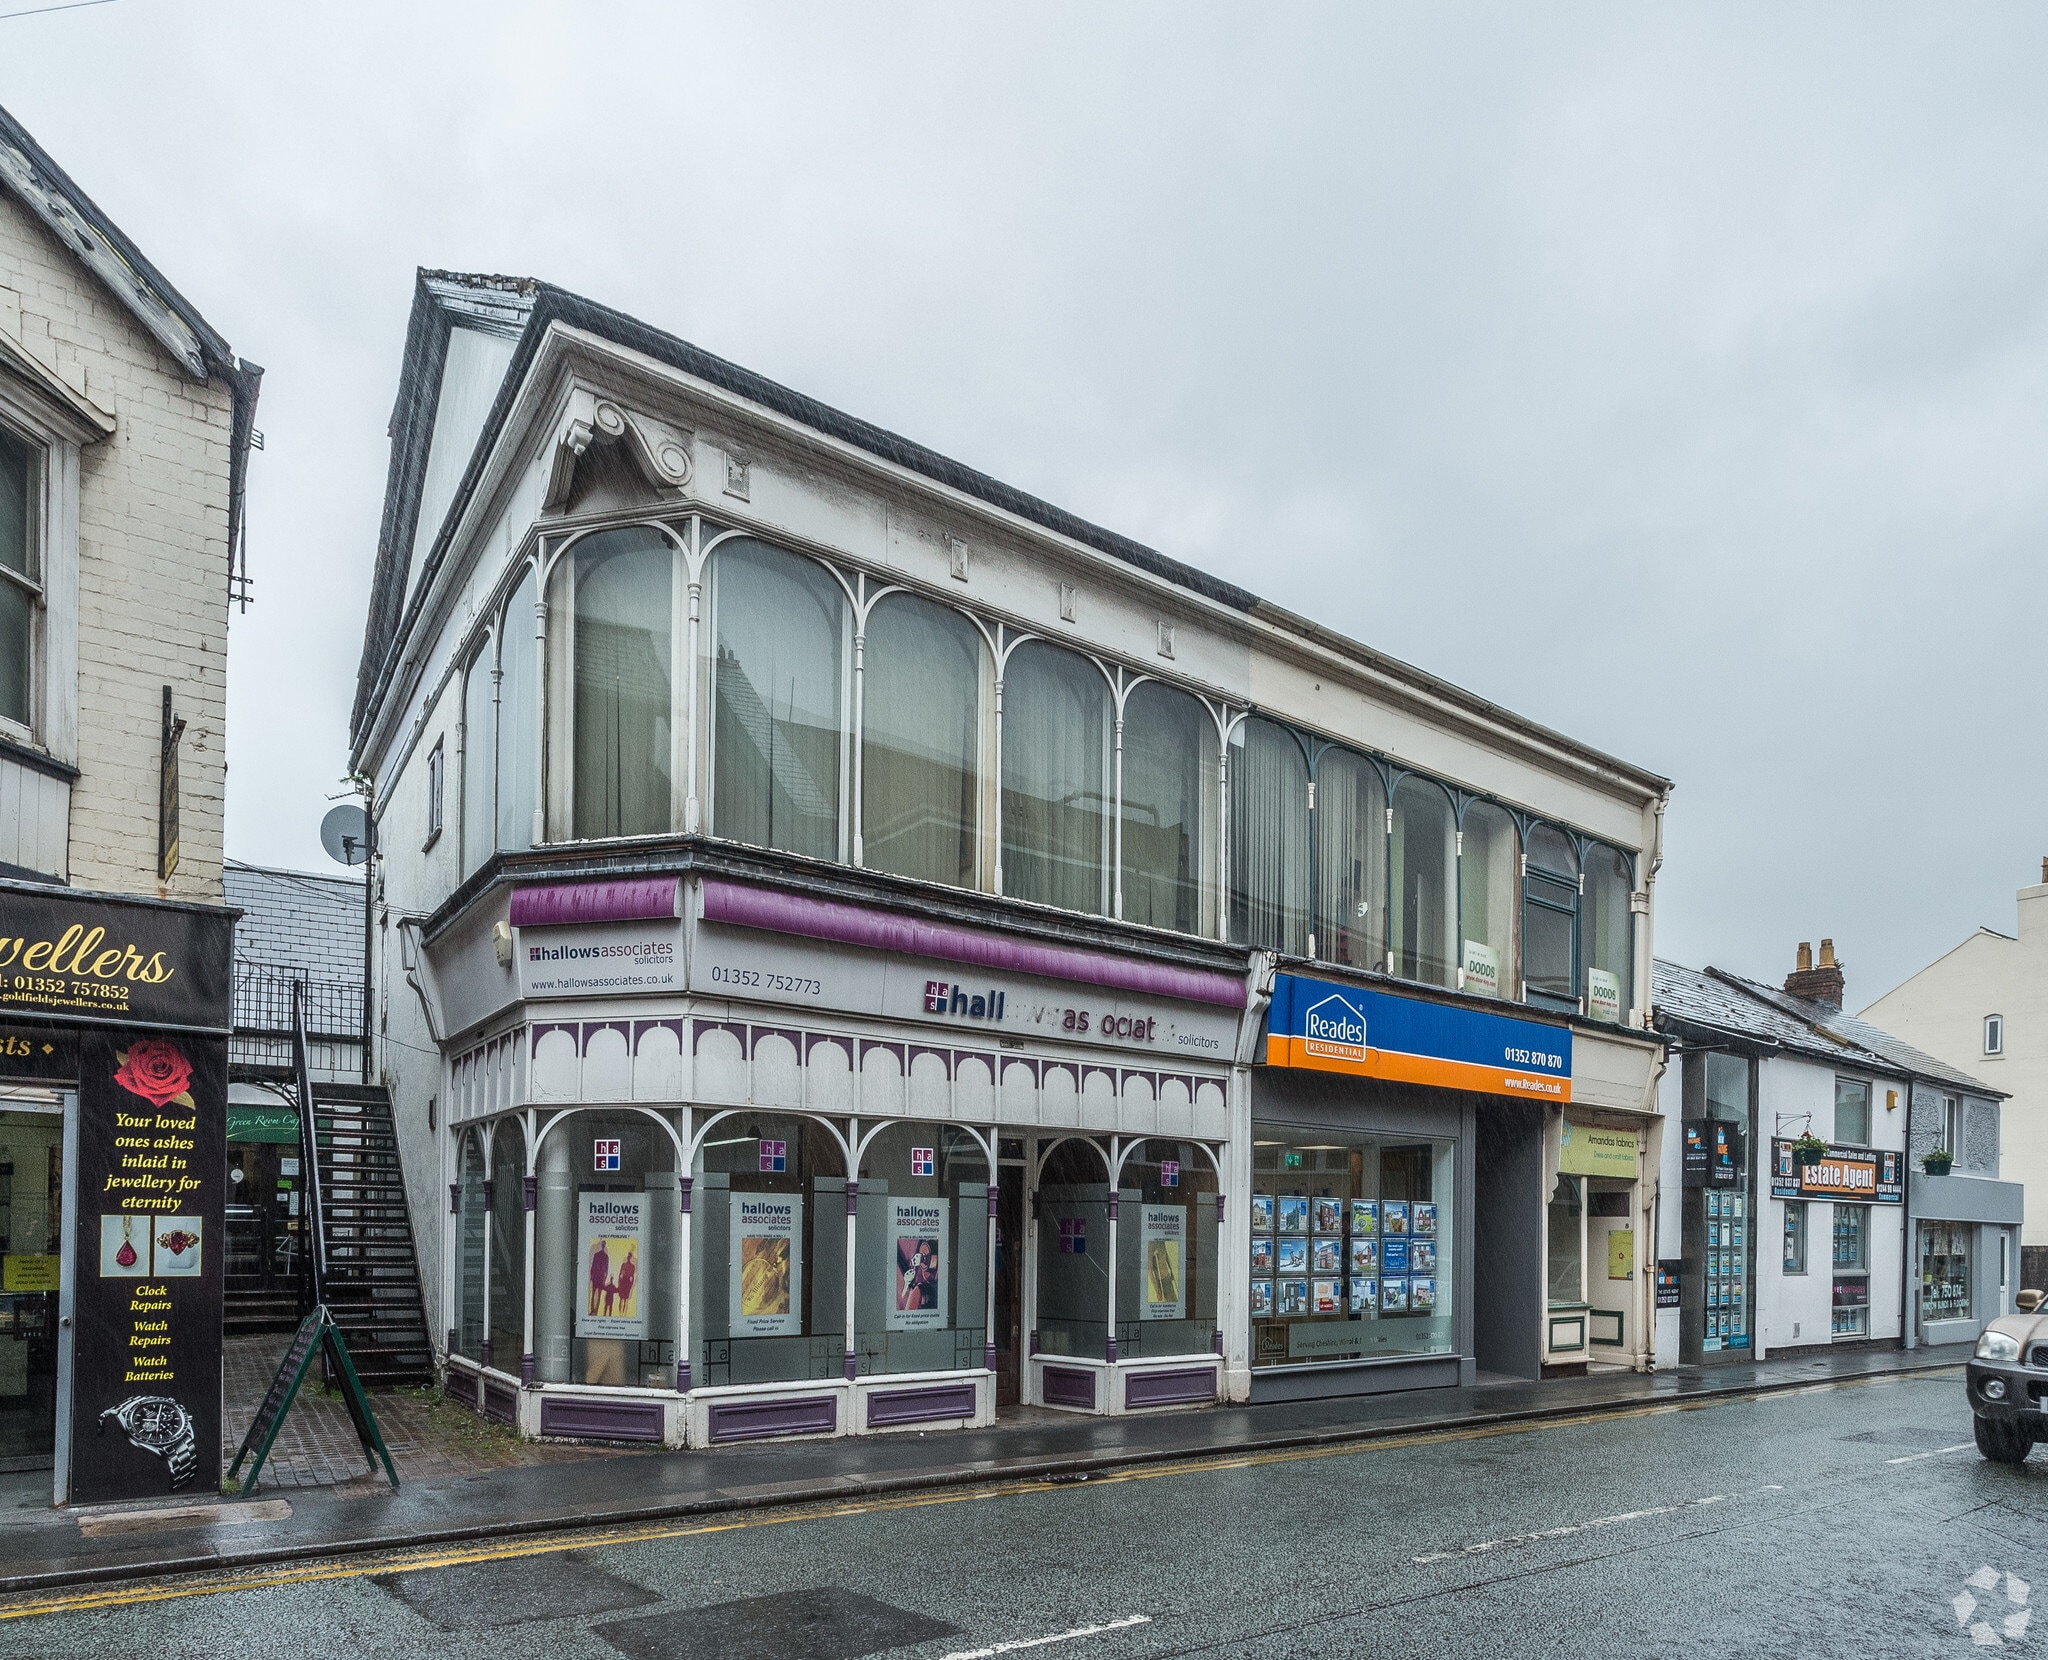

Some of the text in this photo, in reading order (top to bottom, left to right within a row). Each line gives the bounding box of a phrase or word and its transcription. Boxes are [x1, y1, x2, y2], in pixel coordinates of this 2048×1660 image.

[634, 955, 674, 965] solicitors
[1469, 960, 1495, 978] DODDS
[14, 976, 65, 993] 01352
[71, 982, 129, 999] 757852
[531, 974, 674, 989] www.hallowsassociates.co.uk
[711, 966, 821, 995] 01352 752773
[1593, 985, 1616, 1001] DODDS
[1310, 1013, 1363, 1042] Reades
[1178, 1034, 1219, 1049] solicitors
[1310, 1043, 1362, 1057] RESIDENTIAL
[1505, 1047, 1562, 1069] 01352 870 870
[1505, 1078, 1562, 1094] www.Reades.co.uk
[116, 1113, 196, 1130] Your loved
[226, 1116, 252, 1130] Green
[255, 1115, 279, 1127] Room
[115, 1135, 194, 1150] ones ashes
[1588, 1134, 1635, 1148] Amandas fabrics
[122, 1154, 187, 1169] inlaid in
[103, 1174, 201, 1193] jewellery for
[1804, 1164, 1874, 1190] Estate Agent
[122, 1196, 182, 1212] eternity
[589, 1202, 639, 1214] hallows
[742, 1202, 791, 1214] hallows
[896, 1206, 939, 1217] hallows
[1148, 1212, 1180, 1222] hallows
[589, 1214, 639, 1224] associates
[741, 1214, 791, 1224] associates
[896, 1218, 939, 1226] associates
[1148, 1222, 1180, 1230] associates
[135, 1285, 167, 1296] Clock
[129, 1300, 172, 1313] Repairs
[134, 1321, 168, 1331] Watch
[129, 1336, 171, 1348] Repairs
[133, 1356, 167, 1367] Watch
[124, 1371, 174, 1382] Batteries
